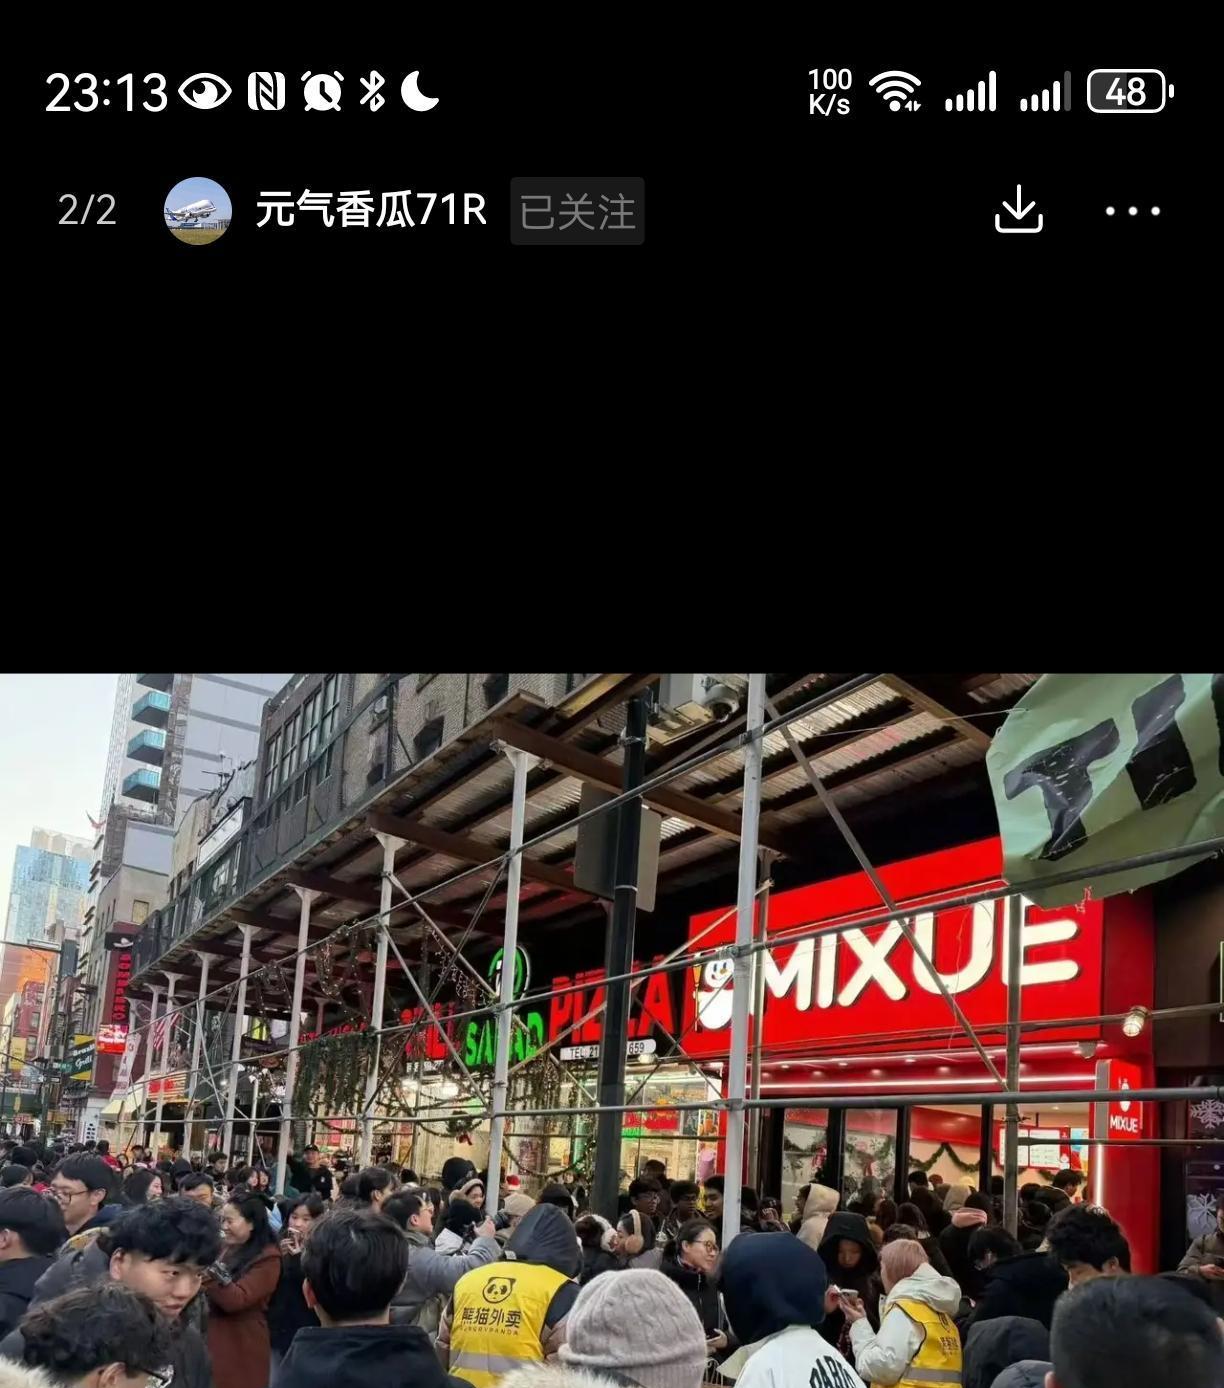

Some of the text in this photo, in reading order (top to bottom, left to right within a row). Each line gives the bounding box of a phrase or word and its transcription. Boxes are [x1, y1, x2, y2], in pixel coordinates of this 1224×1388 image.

[750, 894, 1080, 1016] MIXUE
[465, 1011, 544, 1067] SAAD
[549, 954, 674, 1044] PIZA
[1109, 1114, 1138, 1134] MIXUE
[461, 1306, 522, 1329] 熊猫外卖
